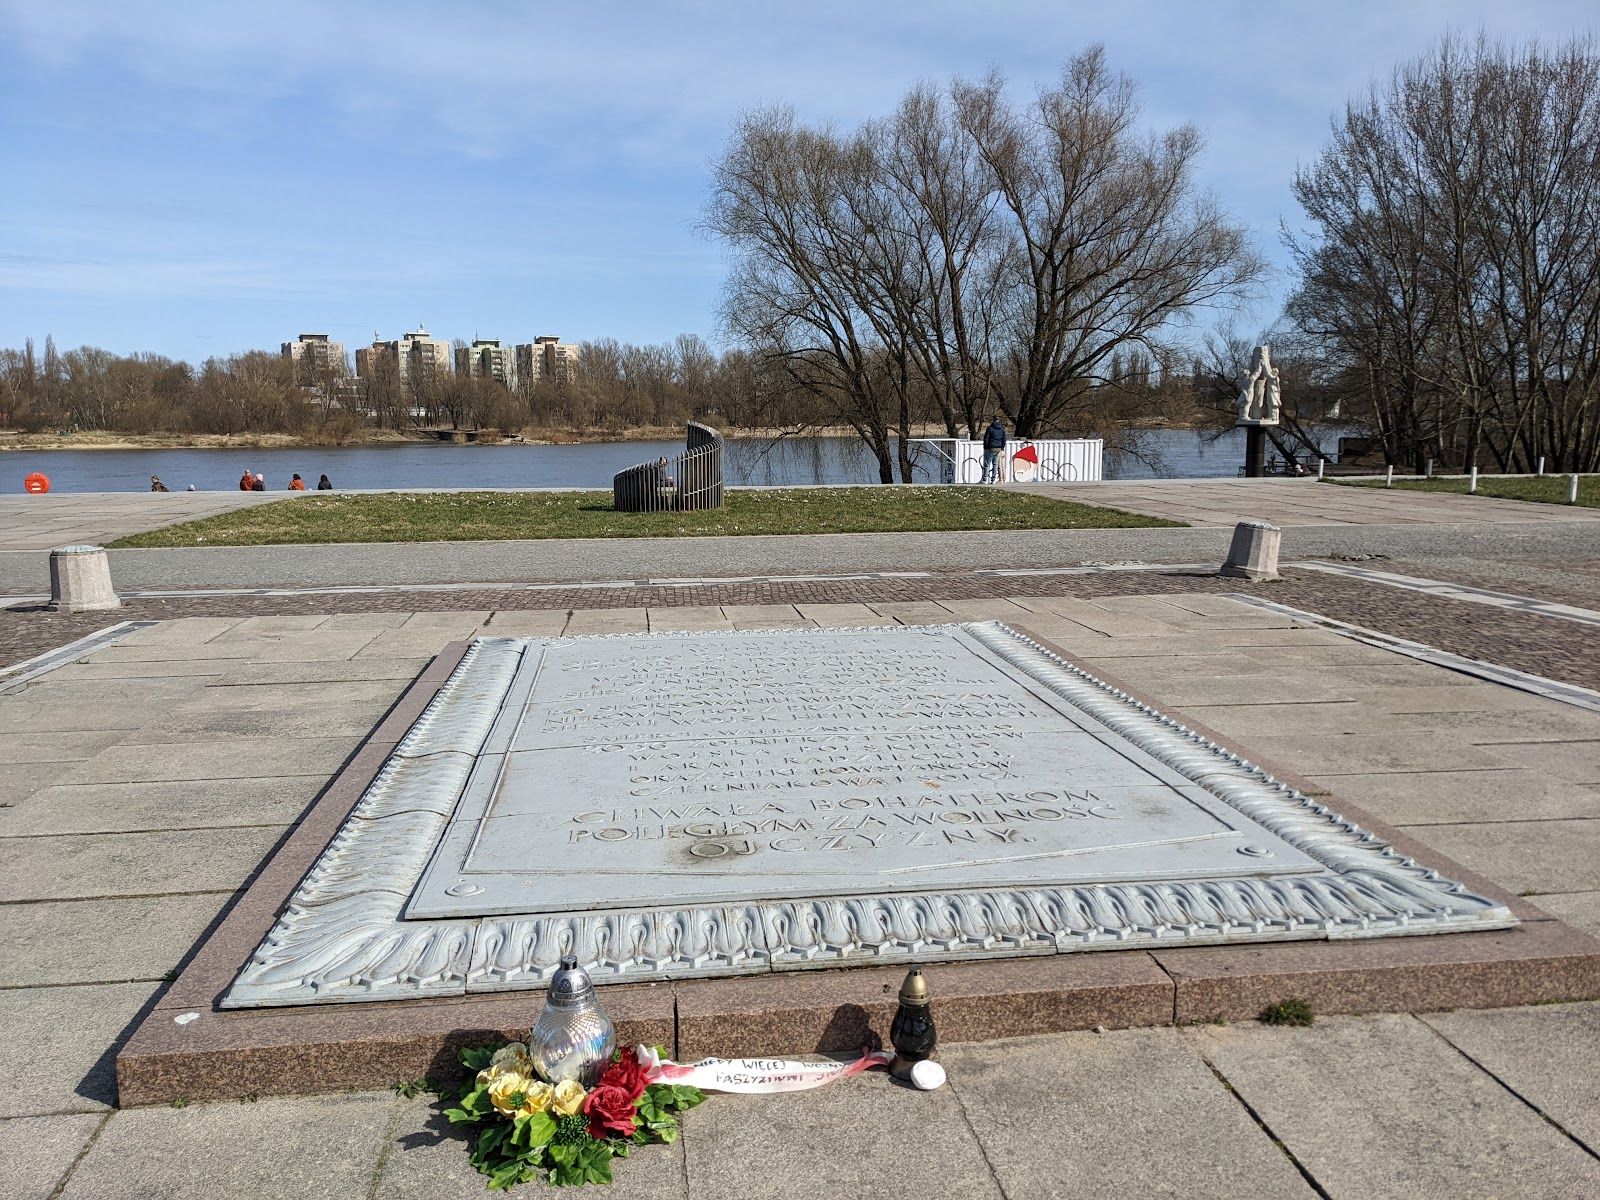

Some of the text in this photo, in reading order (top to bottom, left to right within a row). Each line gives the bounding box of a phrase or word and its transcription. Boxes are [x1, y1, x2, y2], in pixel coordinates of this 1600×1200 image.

[629, 741, 993, 761] WOJSKA POLSKIEGO
[630, 772, 709, 784] ORAZ
[630, 776, 892, 796] CZERNIAKOWA
[573, 789, 1102, 824] CHWAŁA BOHATEROM
[570, 804, 1125, 844] POLEGŁYM ZA WOLNOŚĆ
[689, 829, 1037, 858] OJCZYZNY.
